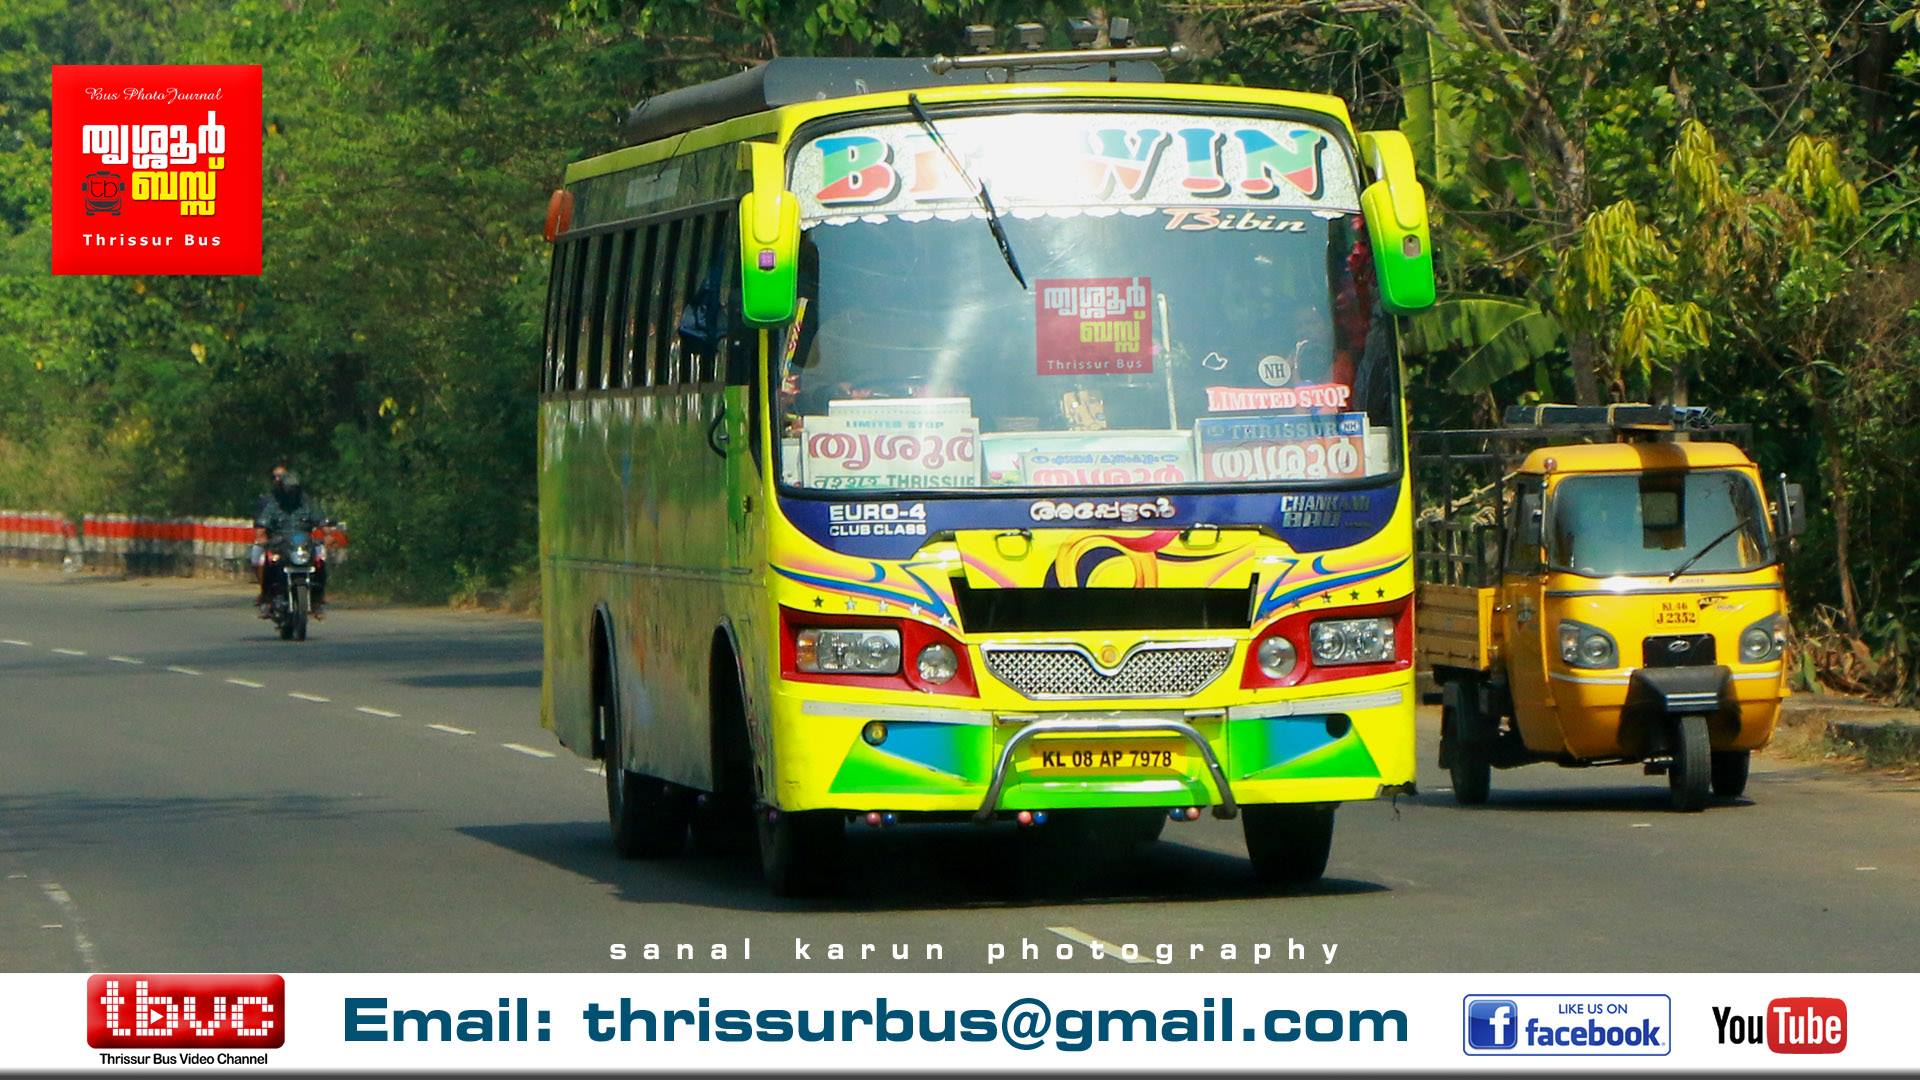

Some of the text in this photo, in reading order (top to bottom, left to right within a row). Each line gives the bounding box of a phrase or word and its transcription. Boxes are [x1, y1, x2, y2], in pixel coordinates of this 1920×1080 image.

[1162, 207, 1307, 233] Bibin
[1263, 363, 1286, 379] NH
[1206, 386, 1351, 411] LIMITED STOP
[1231, 420, 1338, 441] THRISSUR
[828, 503, 927, 521] EURO-4
[829, 523, 928, 537] CLUB CLASS
[1042, 750, 1172, 768] KL 08 AP 7978
